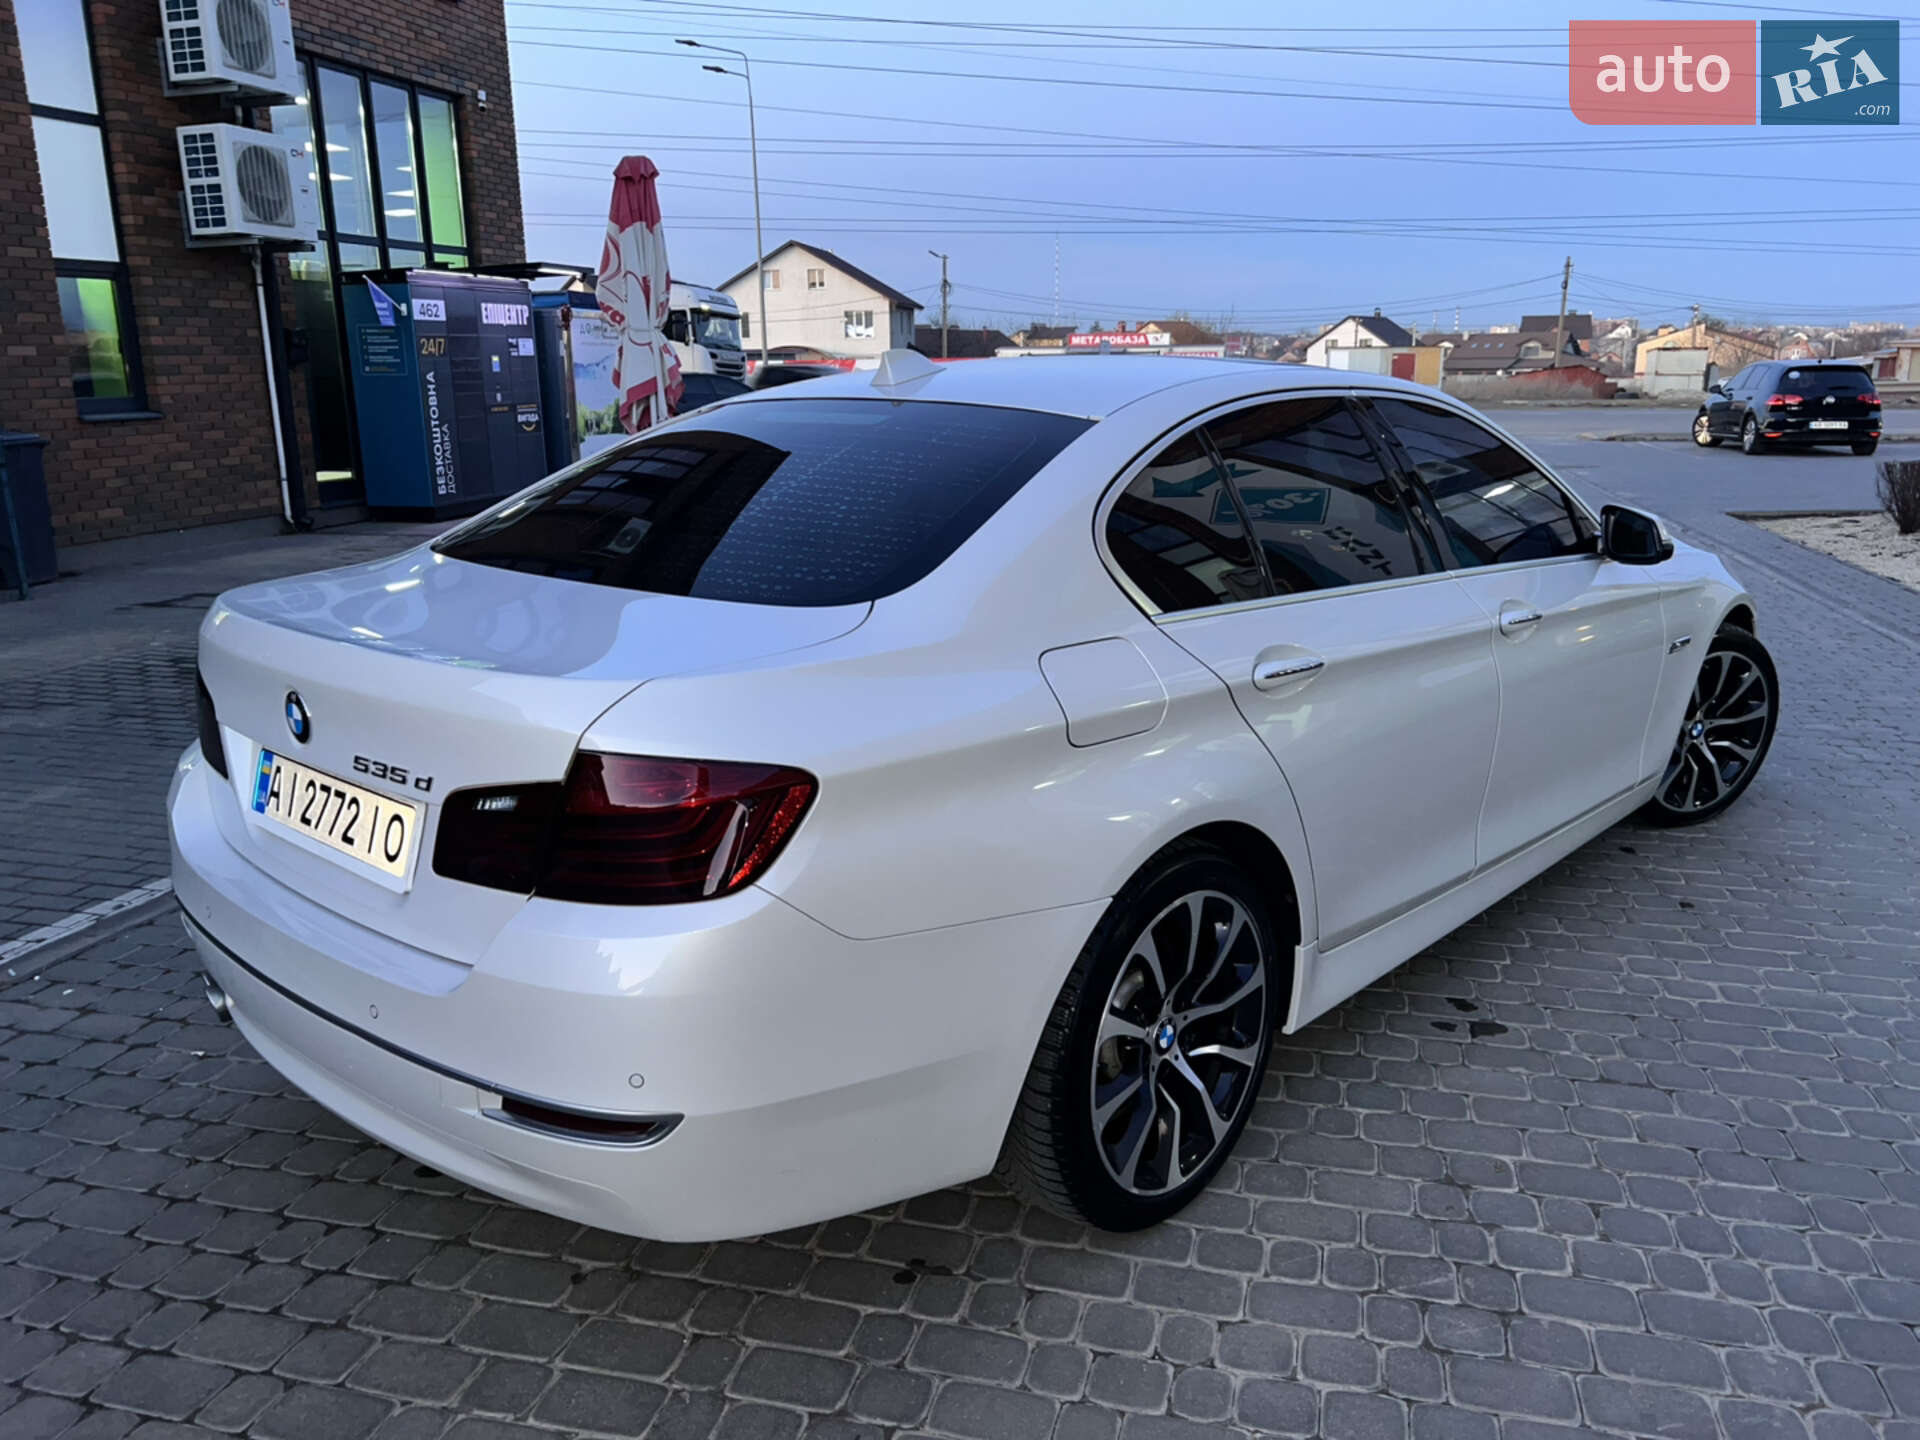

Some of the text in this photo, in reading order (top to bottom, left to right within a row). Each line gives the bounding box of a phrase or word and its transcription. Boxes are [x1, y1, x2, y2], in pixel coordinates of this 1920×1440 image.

[419, 304, 440, 318] 462
[481, 303, 529, 326] ЕПІЦЕНТР
[426, 371, 447, 495] БЕЗКОШТОВНА
[442, 424, 456, 494] ДОСТАВКА
[300, 779, 360, 847] 2772
